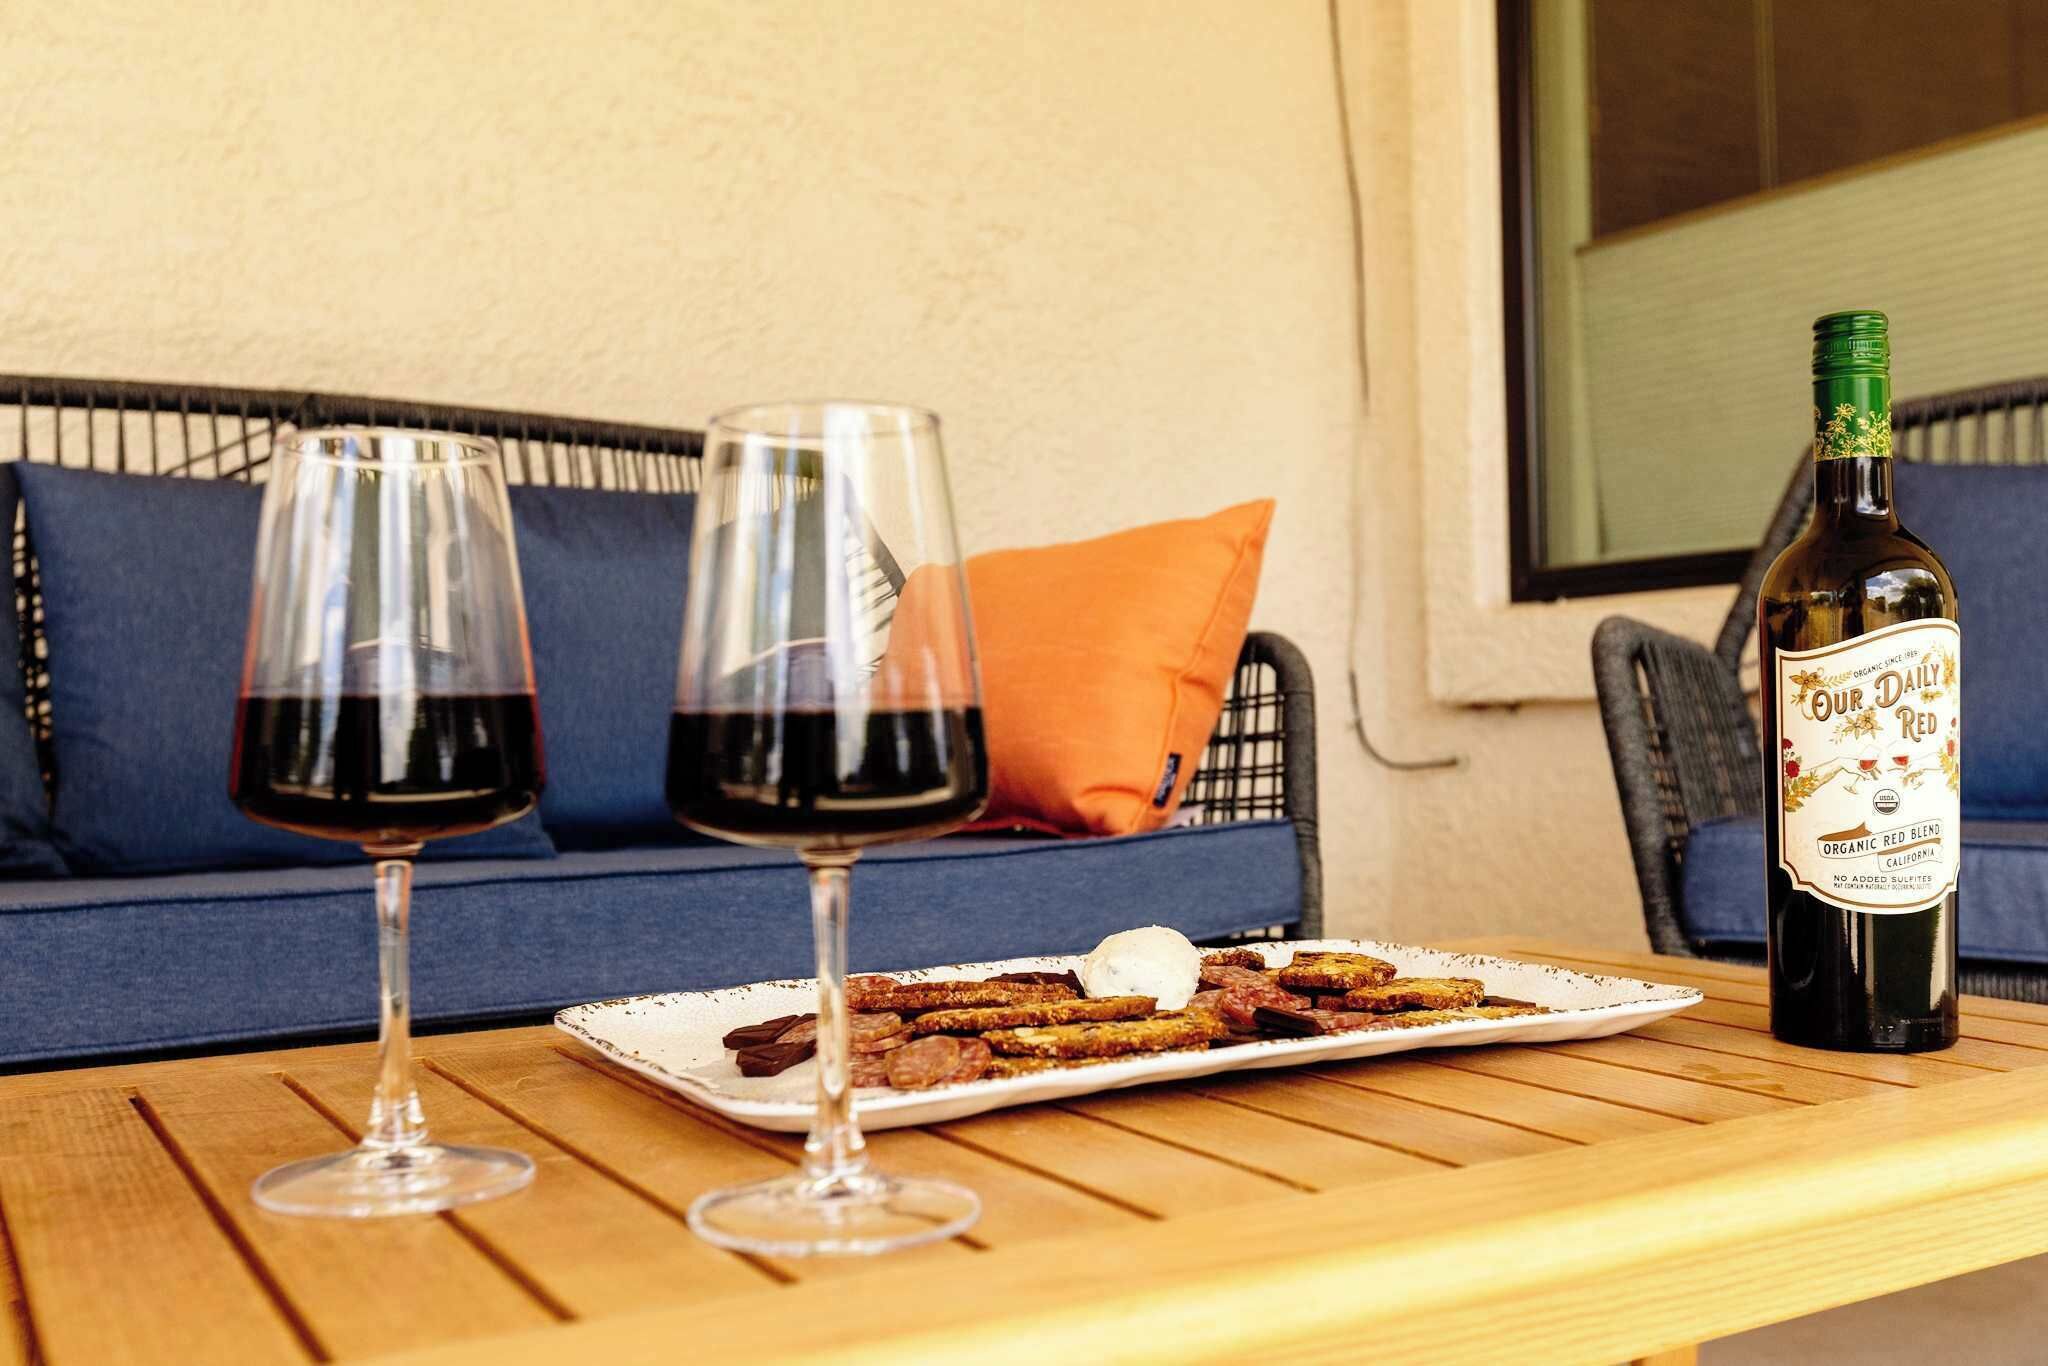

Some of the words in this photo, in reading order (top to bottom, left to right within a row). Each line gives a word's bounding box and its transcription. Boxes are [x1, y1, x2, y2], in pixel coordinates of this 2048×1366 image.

[1854, 663, 1883, 678] ORGANIC
[1885, 654, 1902, 667] SINCE
[1812, 687, 1863, 721] OUR
[1874, 663, 1940, 708] DAILY
[1895, 705, 1938, 743] RED
[1823, 838, 1877, 855] ORGANIC
[1883, 831, 1906, 847] RED
[1911, 823, 1941, 840] BLEND
[1886, 848, 1935, 868] CALIFORNIA
[1852, 875, 1887, 883] ADDED
[1891, 875, 1933, 883] SULFITES
